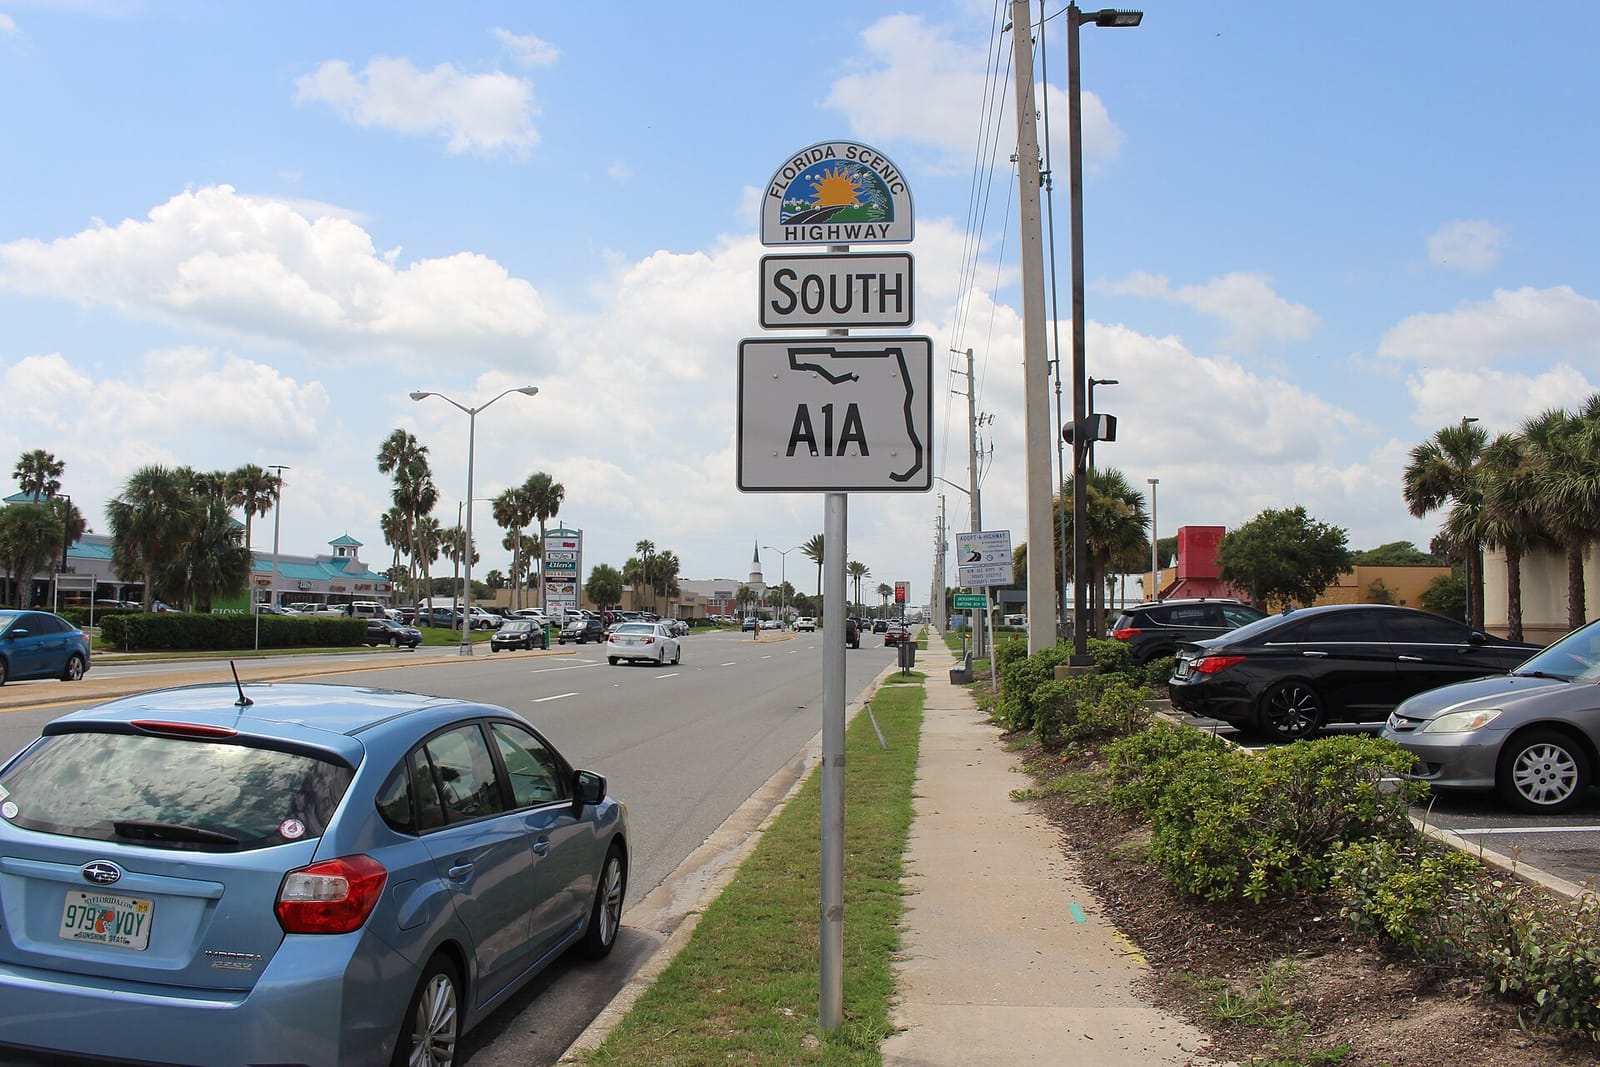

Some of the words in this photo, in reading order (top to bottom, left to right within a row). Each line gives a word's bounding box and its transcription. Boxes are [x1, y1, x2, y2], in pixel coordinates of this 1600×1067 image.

[769, 145, 836, 200] FLORIDA
[845, 146, 904, 197] SCENIC
[785, 223, 890, 241] HIGHWAY
[771, 268, 903, 315] SOUTH
[785, 403, 870, 456] A1A
[65, 905, 96, 931] 979
[116, 910, 145, 937] VQY
[78, 931, 106, 942] SUNSHINE
[108, 935, 127, 944] STATE
[205, 950, 263, 961] IMPREZA
